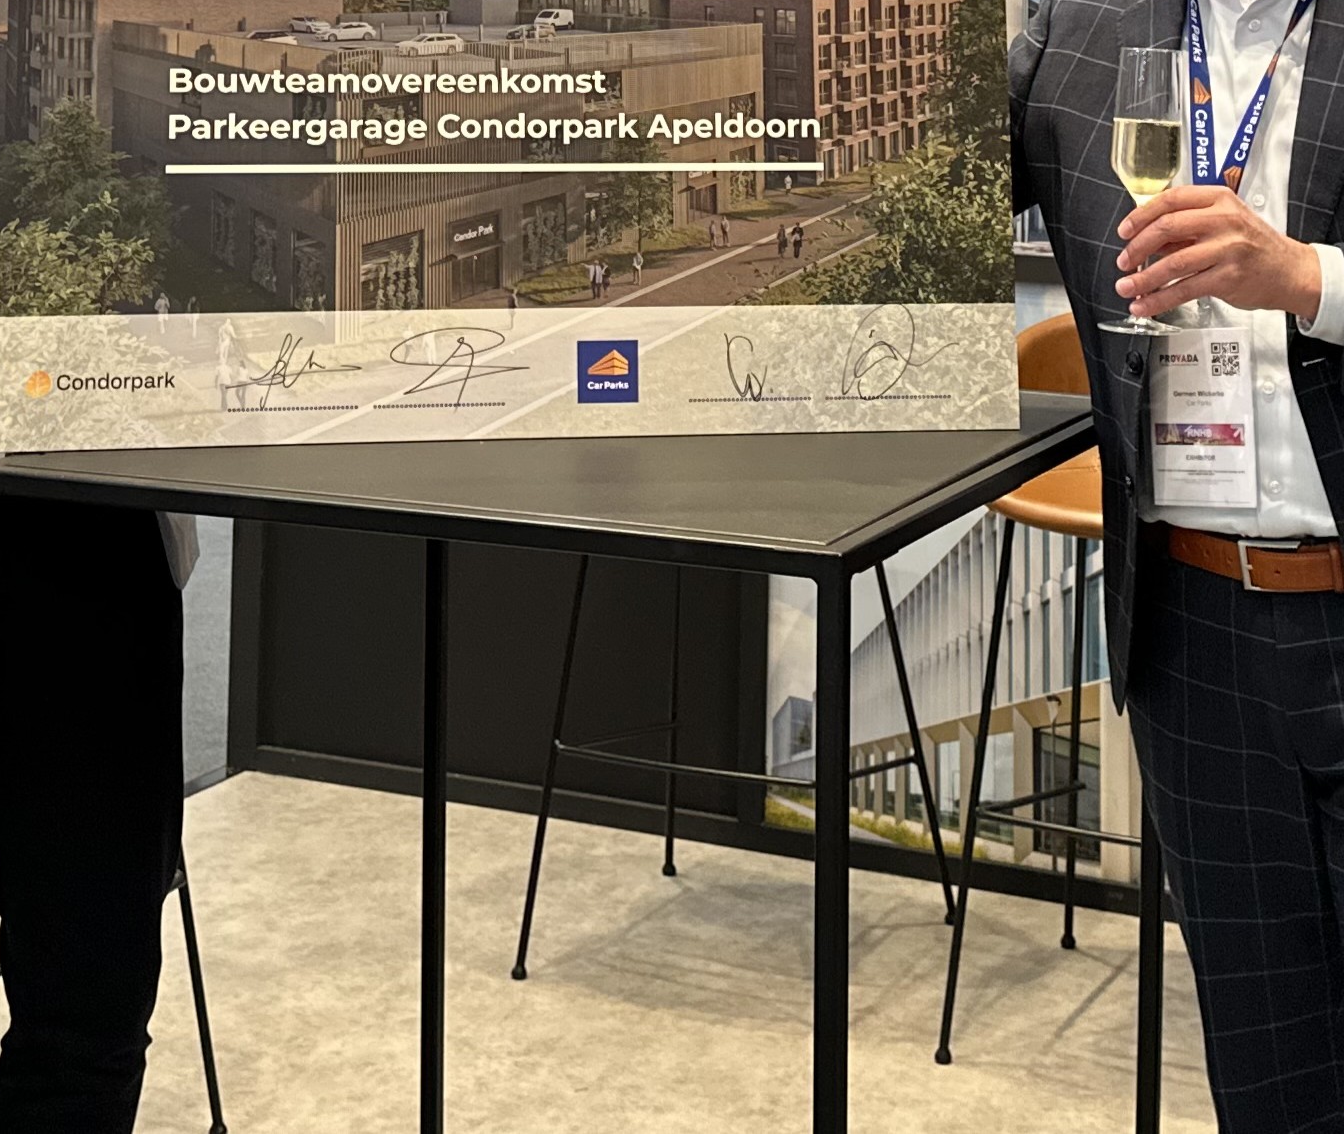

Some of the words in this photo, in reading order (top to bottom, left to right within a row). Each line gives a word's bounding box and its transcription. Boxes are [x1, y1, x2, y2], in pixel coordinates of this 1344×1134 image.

[1189, 0, 1198, 26] Car
[1191, 24, 1202, 64] Parks
[168, 67, 607, 94] Bouwteamovereenkomst
[167, 112, 428, 145] Parkeergarage
[436, 112, 639, 145] Condorpark
[646, 112, 822, 145] Apeldoorn
[1194, 109, 1208, 136] Car
[1234, 136, 1251, 162] Car
[1244, 94, 1266, 136] Parks
[1195, 136, 1209, 178] Parks
[1159, 353, 1199, 363] PROVADA
[55, 371, 176, 394] Condorpark
[586, 380, 604, 391] Car
[604, 380, 629, 391] Parks
